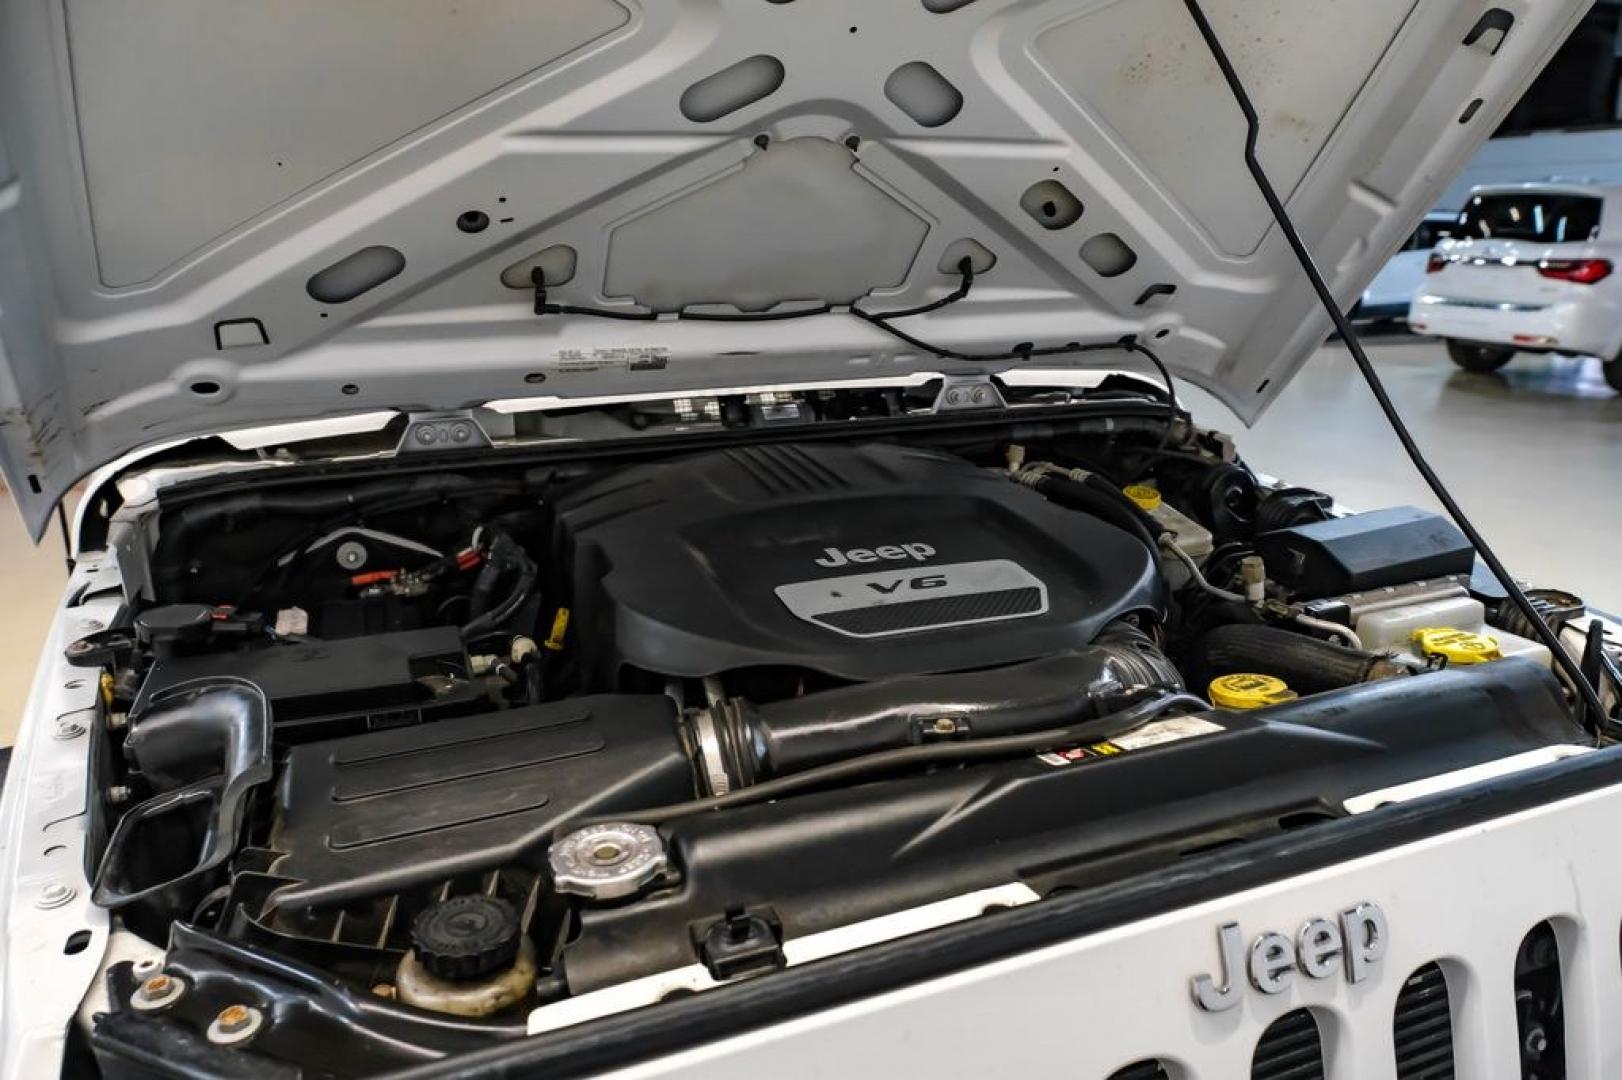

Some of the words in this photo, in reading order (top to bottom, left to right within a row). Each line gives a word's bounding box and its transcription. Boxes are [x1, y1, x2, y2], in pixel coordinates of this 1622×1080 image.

[815, 542, 936, 568] Jeep
[866, 574, 947, 594] V6
[1190, 902, 1388, 1013] Jeep
